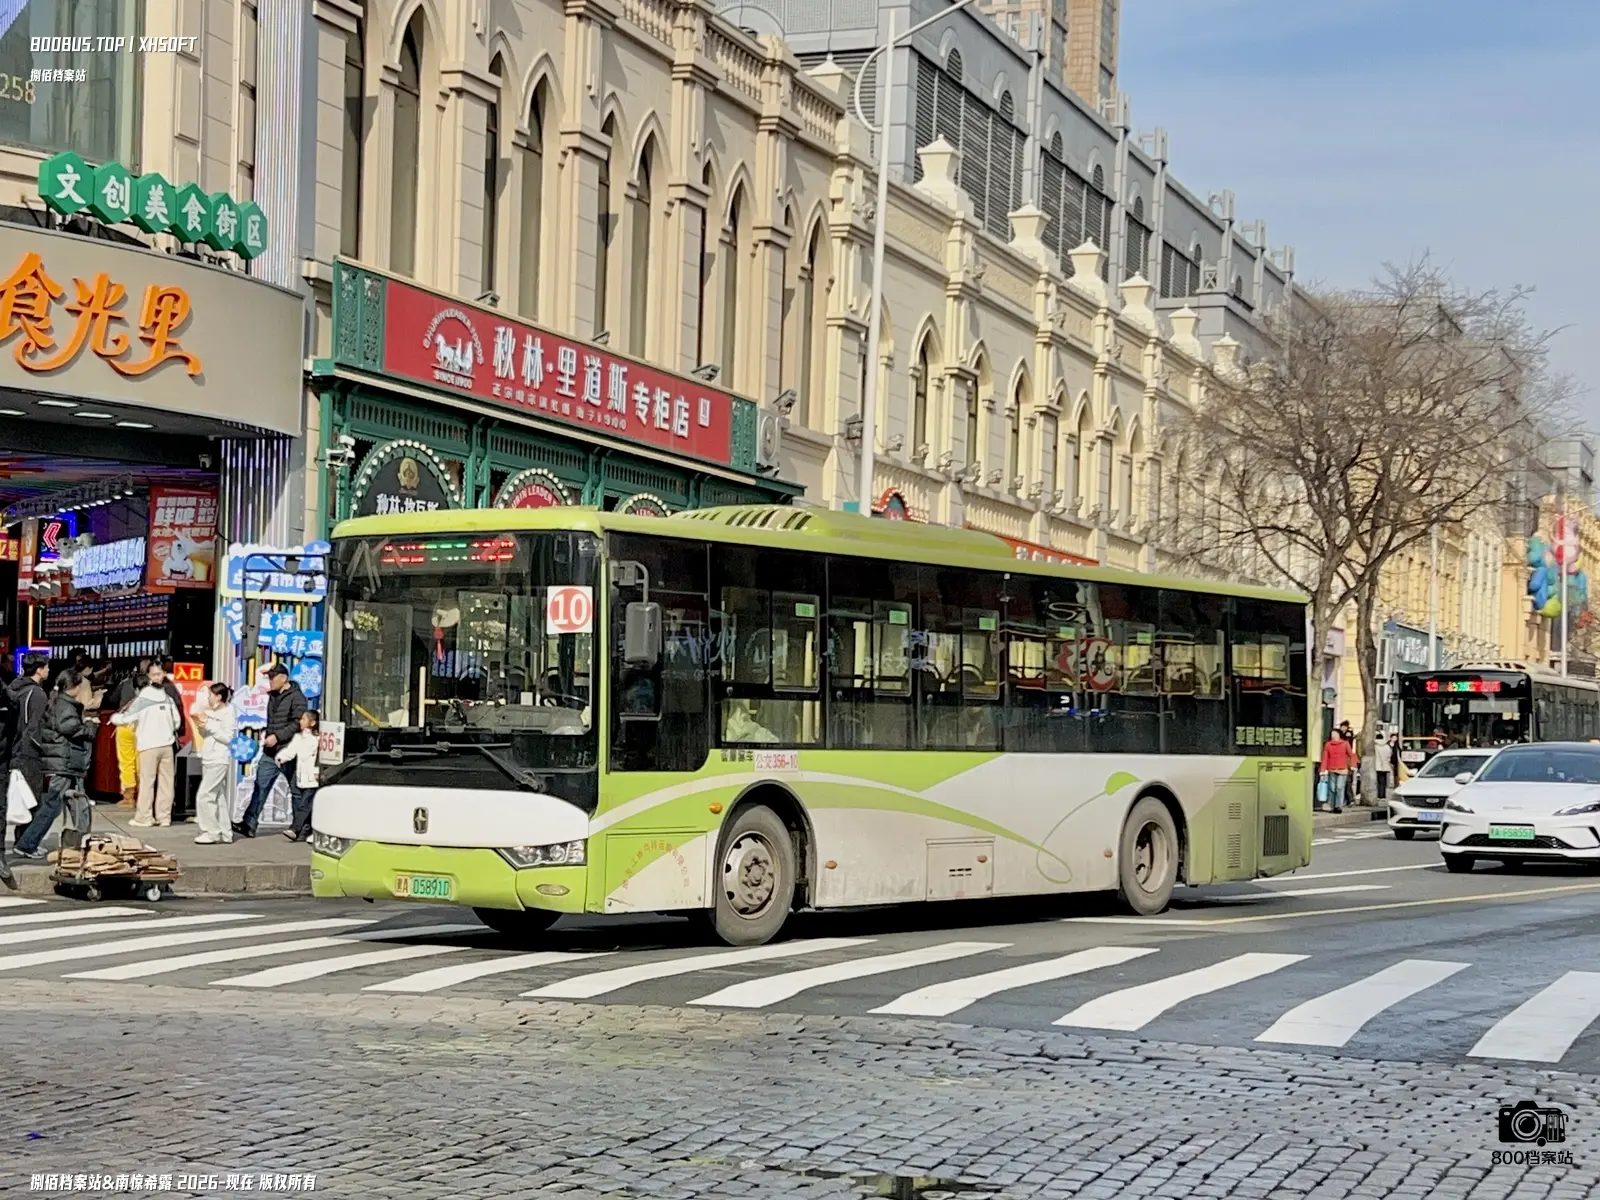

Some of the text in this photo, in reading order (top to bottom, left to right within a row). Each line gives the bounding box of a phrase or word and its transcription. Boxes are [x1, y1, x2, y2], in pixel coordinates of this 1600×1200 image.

[55, 164, 262, 248] 文创美食街区
[0, 252, 203, 377] 食光里
[553, 593, 588, 626] 10
[175, 667, 202, 681] 入口
